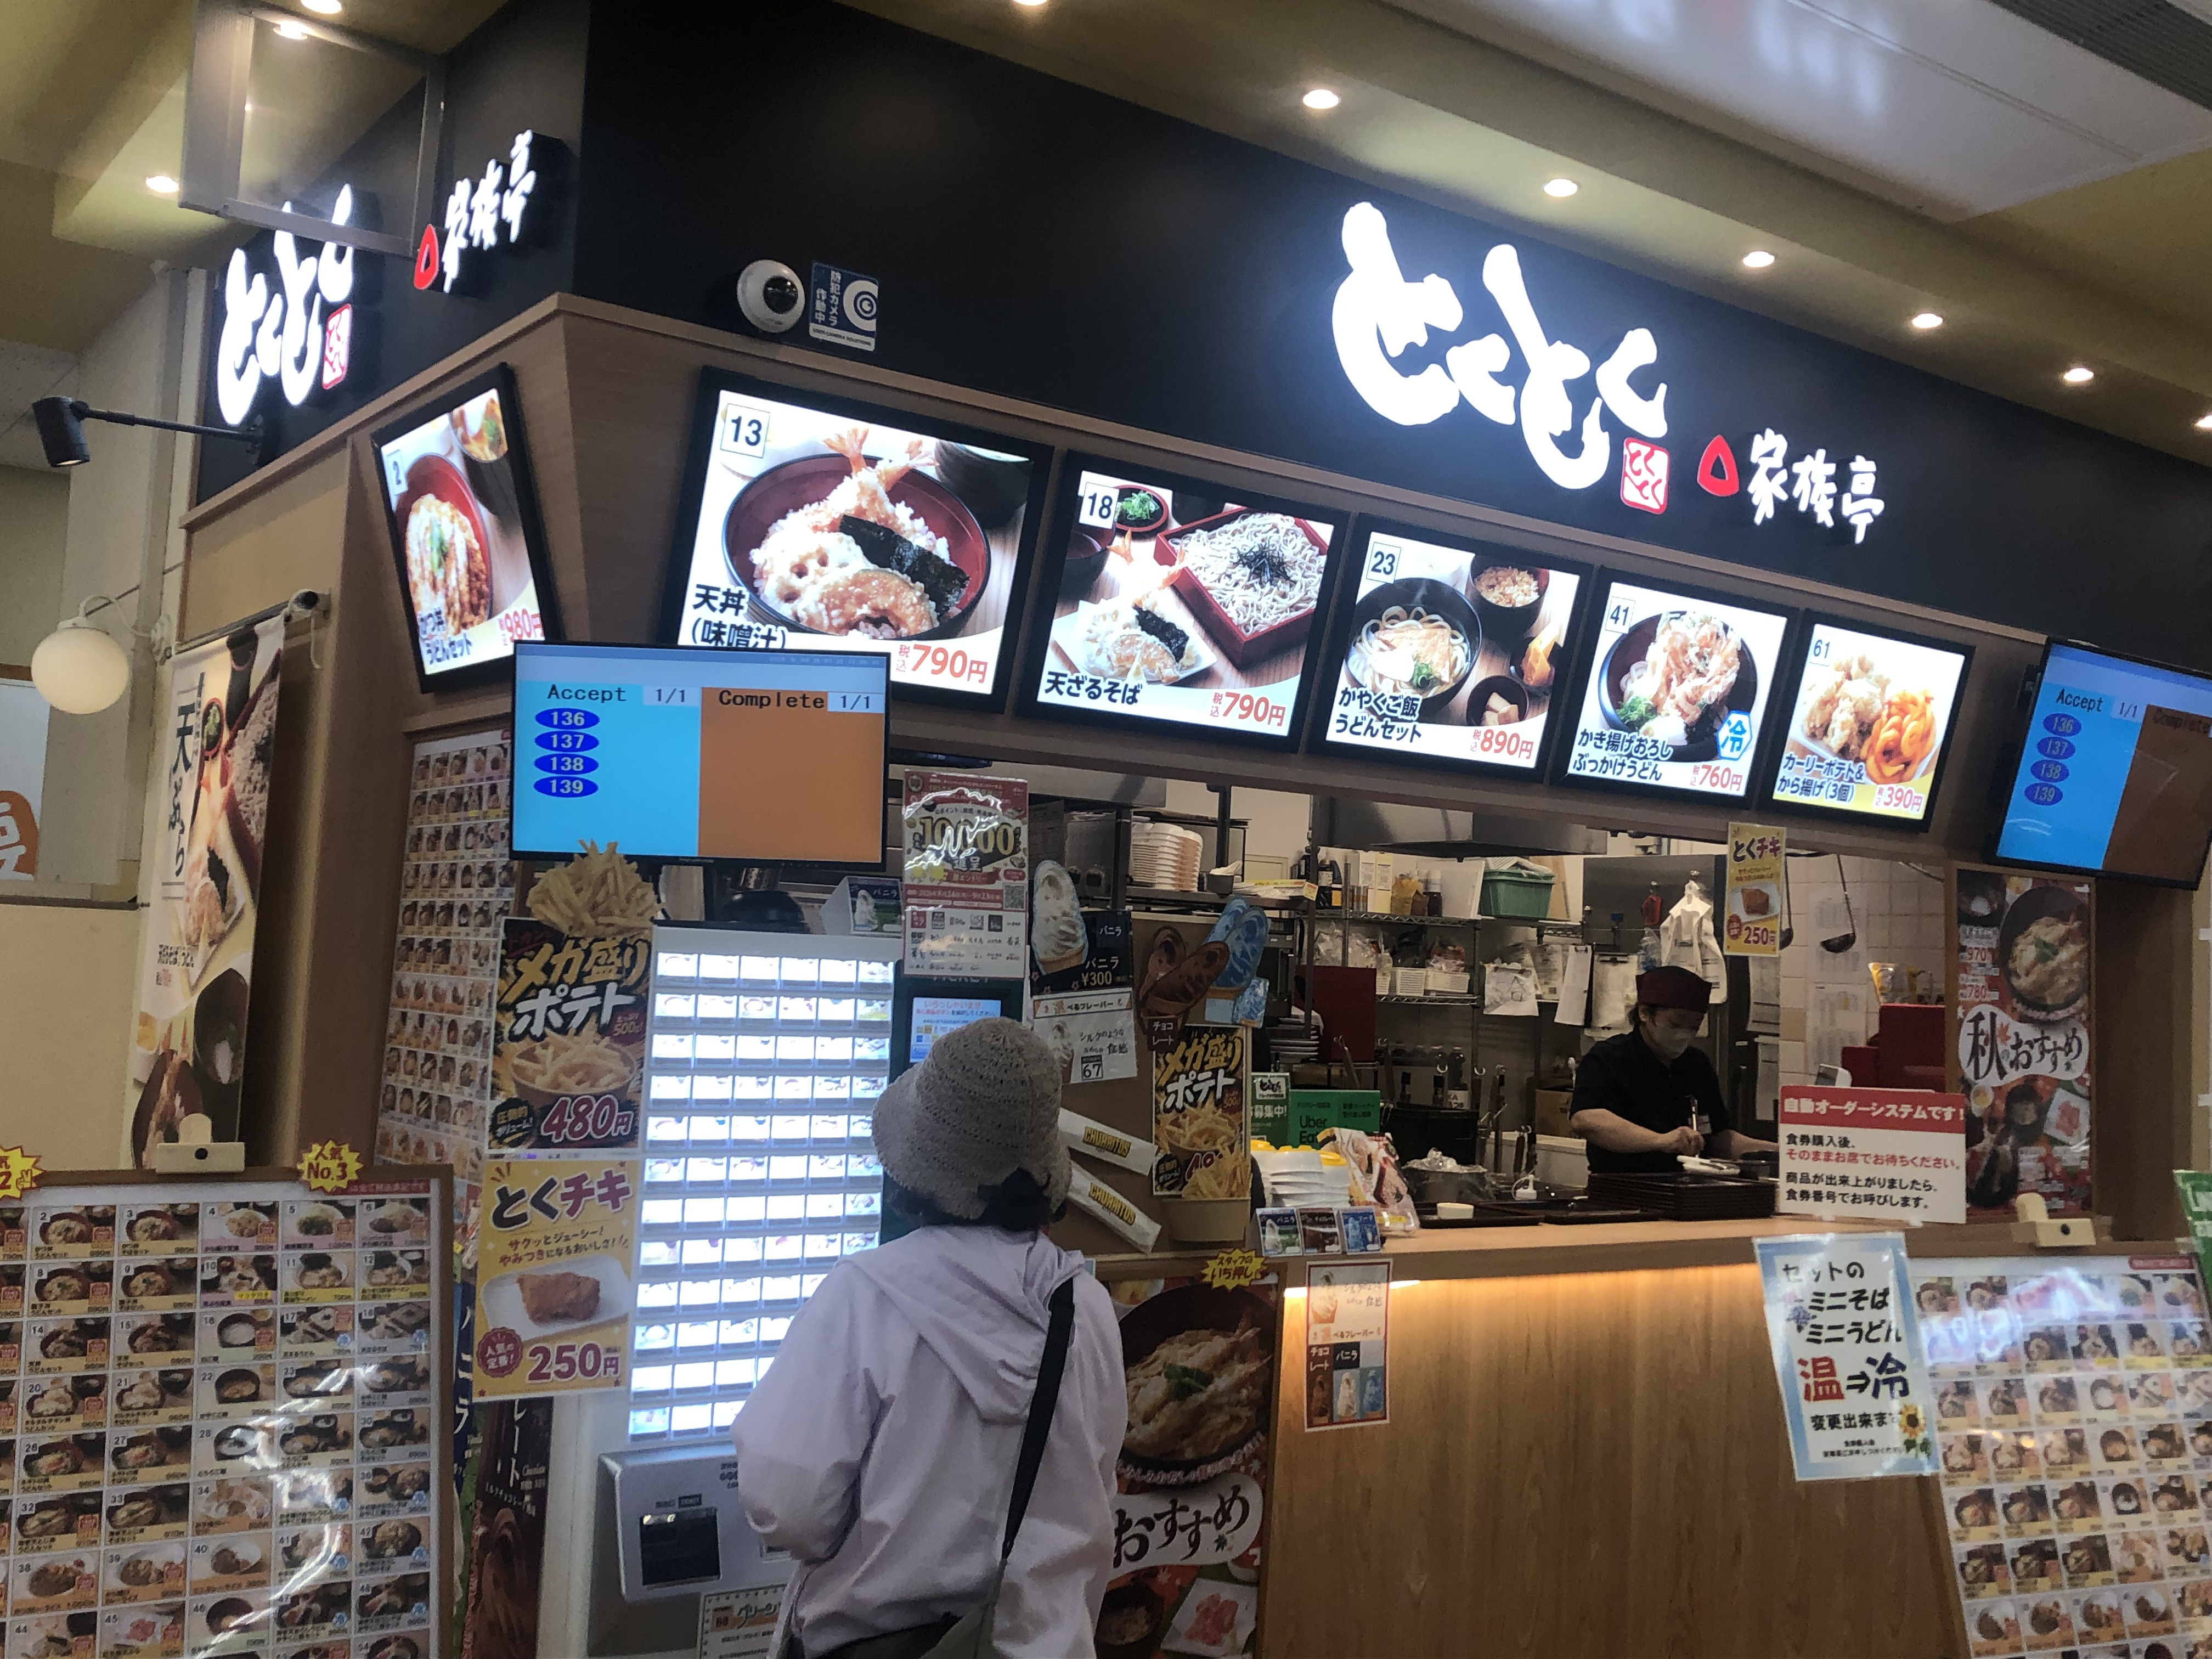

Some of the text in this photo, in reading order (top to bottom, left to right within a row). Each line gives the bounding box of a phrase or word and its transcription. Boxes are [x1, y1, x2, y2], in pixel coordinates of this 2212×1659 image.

[442, 129, 535, 293] 家族亭
[815, 287, 827, 323] 作動中
[829, 270, 842, 326] 防犯カメラ
[1332, 201, 1668, 490] とくとく
[730, 416, 763, 447] 13
[1748, 428, 1884, 544] 家族亭
[1088, 492, 1113, 520] 18
[1371, 551, 1395, 575] 23
[693, 584, 747, 617] 天丼
[1610, 605, 1629, 626] 41
[1813, 639, 1831, 659] 61
[911, 644, 989, 685] 790円
[547, 685, 686, 704] Accept 1/1
[719, 690, 871, 710] Complete 1/1
[1045, 671, 1142, 705] 天ざるそば
[1210, 692, 1285, 726] 税込 790円
[1339, 687, 1420, 718] かやくご飯
[2056, 689, 2138, 718] Accept 1/1
[550, 712, 585, 726] 136
[1335, 714, 1421, 743] うどんセット
[2053, 717, 2073, 733] 136
[549, 735, 584, 749] 137
[1481, 729, 1534, 759] 890円
[1579, 729, 1672, 758] かき揚げおろし
[1722, 719, 1747, 753] 冷
[2046, 740, 2068, 757] 137
[550, 757, 584, 772] 138
[1573, 753, 1662, 781] ぶっかけうどん
[1783, 754, 1865, 781] カーリーポテト&
[2040, 763, 2061, 780] 138
[549, 780, 583, 794] 139
[1699, 764, 1743, 791] 760円
[1883, 787, 1923, 812] 390円
[2034, 786, 2055, 802] 139
[1733, 837, 1781, 862] とくチキ
[1099, 924, 1122, 936] バニラ
[1743, 926, 1775, 946] 250円
[503, 939, 650, 1003] メガ盛り
[1085, 956, 1120, 969] バニラ
[1081, 972, 1113, 986] ¥300
[513, 982, 637, 1037] ポテト
[1152, 1021, 1173, 1032] チョコ
[1152, 1035, 1174, 1046] レート
[1159, 1033, 1243, 1081] メガ盛り
[1082, 1063, 1102, 1077] 67
[1165, 1069, 1237, 1110] ポテト
[543, 1097, 633, 1141] 480円
[1299, 1115, 1327, 1128] Uber
[307, 1162, 349, 1181] No.3
[1786, 1149, 1960, 1170] そのままお席でお待ちください。
[493, 1170, 631, 1229] とくチキ
[1786, 1189, 1928, 1209] 食券番号でお呼びします。
[509, 1226, 603, 1251] サクッとジューシー!
[1782, 1261, 1864, 1282] セットの
[1806, 1319, 1902, 1344] ミニうどん
[528, 1343, 619, 1381] 250円
[1310, 1347, 1330, 1357] チョコ
[1336, 1350, 1358, 1361] バニラ
[1310, 1360, 1330, 1372] レート
[1797, 1356, 1845, 1402] 温
[1866, 1352, 1910, 1399] 冷
[29, 1384, 41, 1392] 20
[116, 1378, 128, 1386] 21
[21, 1503, 35, 1511] 32
[1113, 1484, 1250, 1568] おすすめ
[15, 1626, 27, 1634] 44
